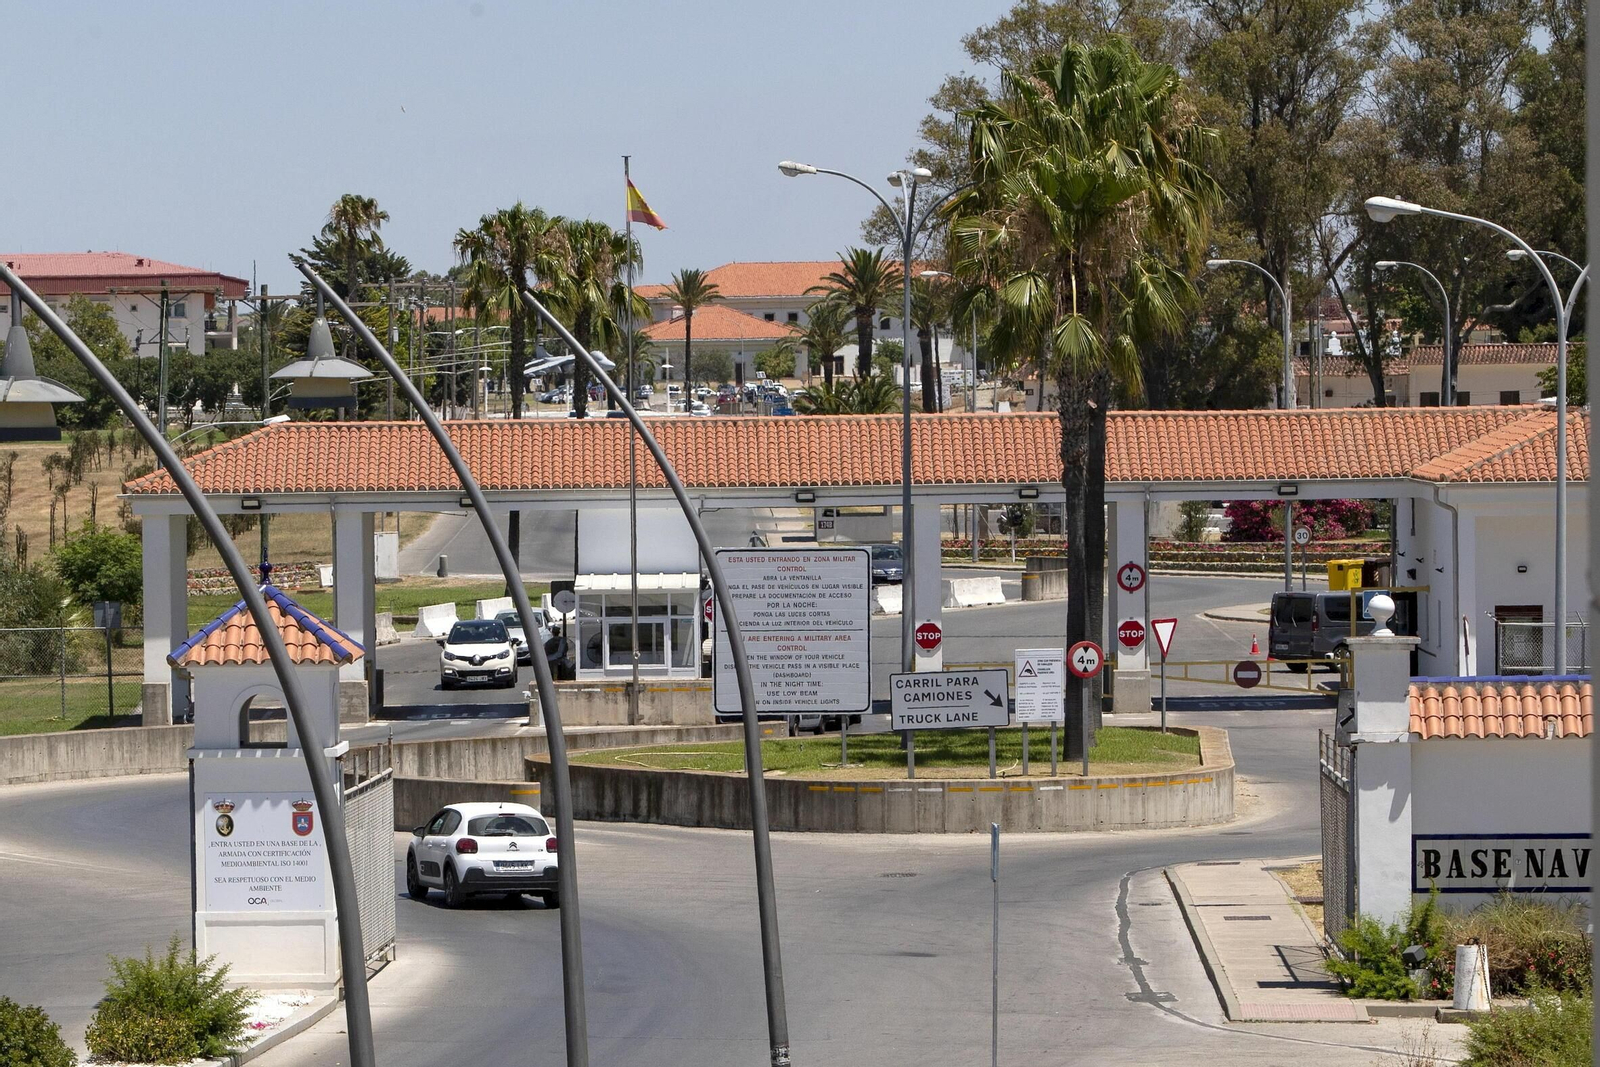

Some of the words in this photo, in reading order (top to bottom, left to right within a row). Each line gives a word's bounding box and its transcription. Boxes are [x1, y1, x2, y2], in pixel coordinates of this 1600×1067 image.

[1296, 532, 1309, 540] 30
[916, 632, 941, 640] STOP
[1119, 630, 1145, 638] STOP
[895, 678, 942, 689] CARRIL
[946, 676, 980, 687] PARA
[903, 690, 973, 703] CAMIONES
[899, 713, 942, 724] TRUCK
[946, 711, 979, 722] LANE
[1422, 849, 1512, 879] BASE
[247, 897, 268, 905] OCA
